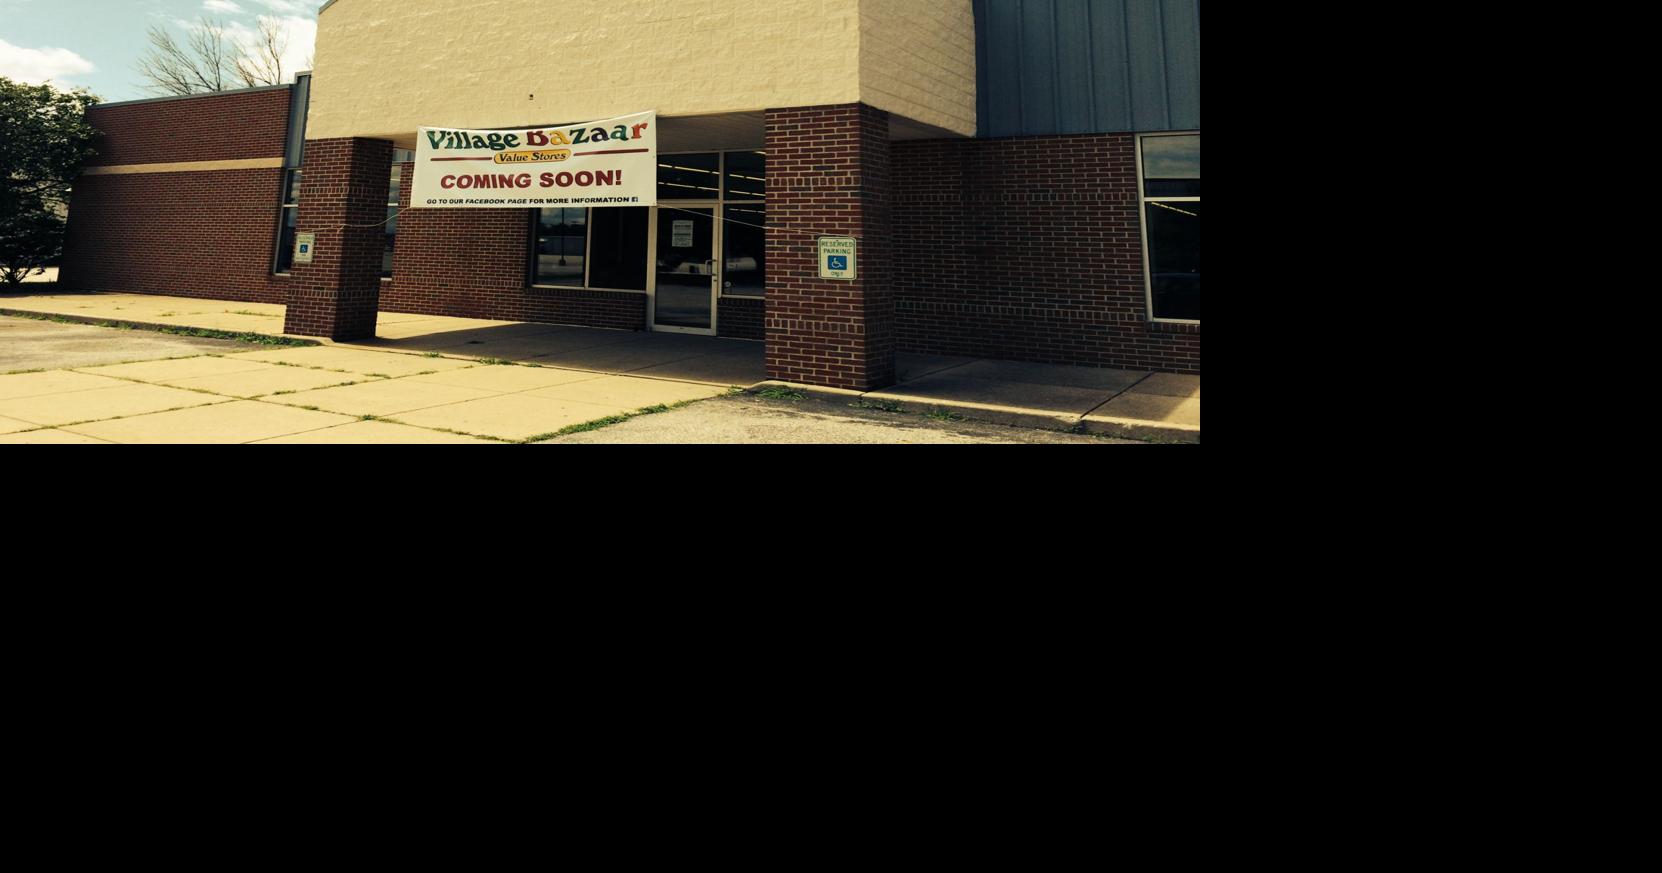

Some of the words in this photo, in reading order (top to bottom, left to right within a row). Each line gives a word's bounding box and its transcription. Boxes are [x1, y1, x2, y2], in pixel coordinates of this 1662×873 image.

[426, 130, 521, 151] Village
[526, 122, 648, 146] Bazaar
[499, 152, 528, 162] Value
[531, 151, 566, 160] Stores
[440, 173, 532, 189] COMING
[539, 170, 622, 188] SOON!
